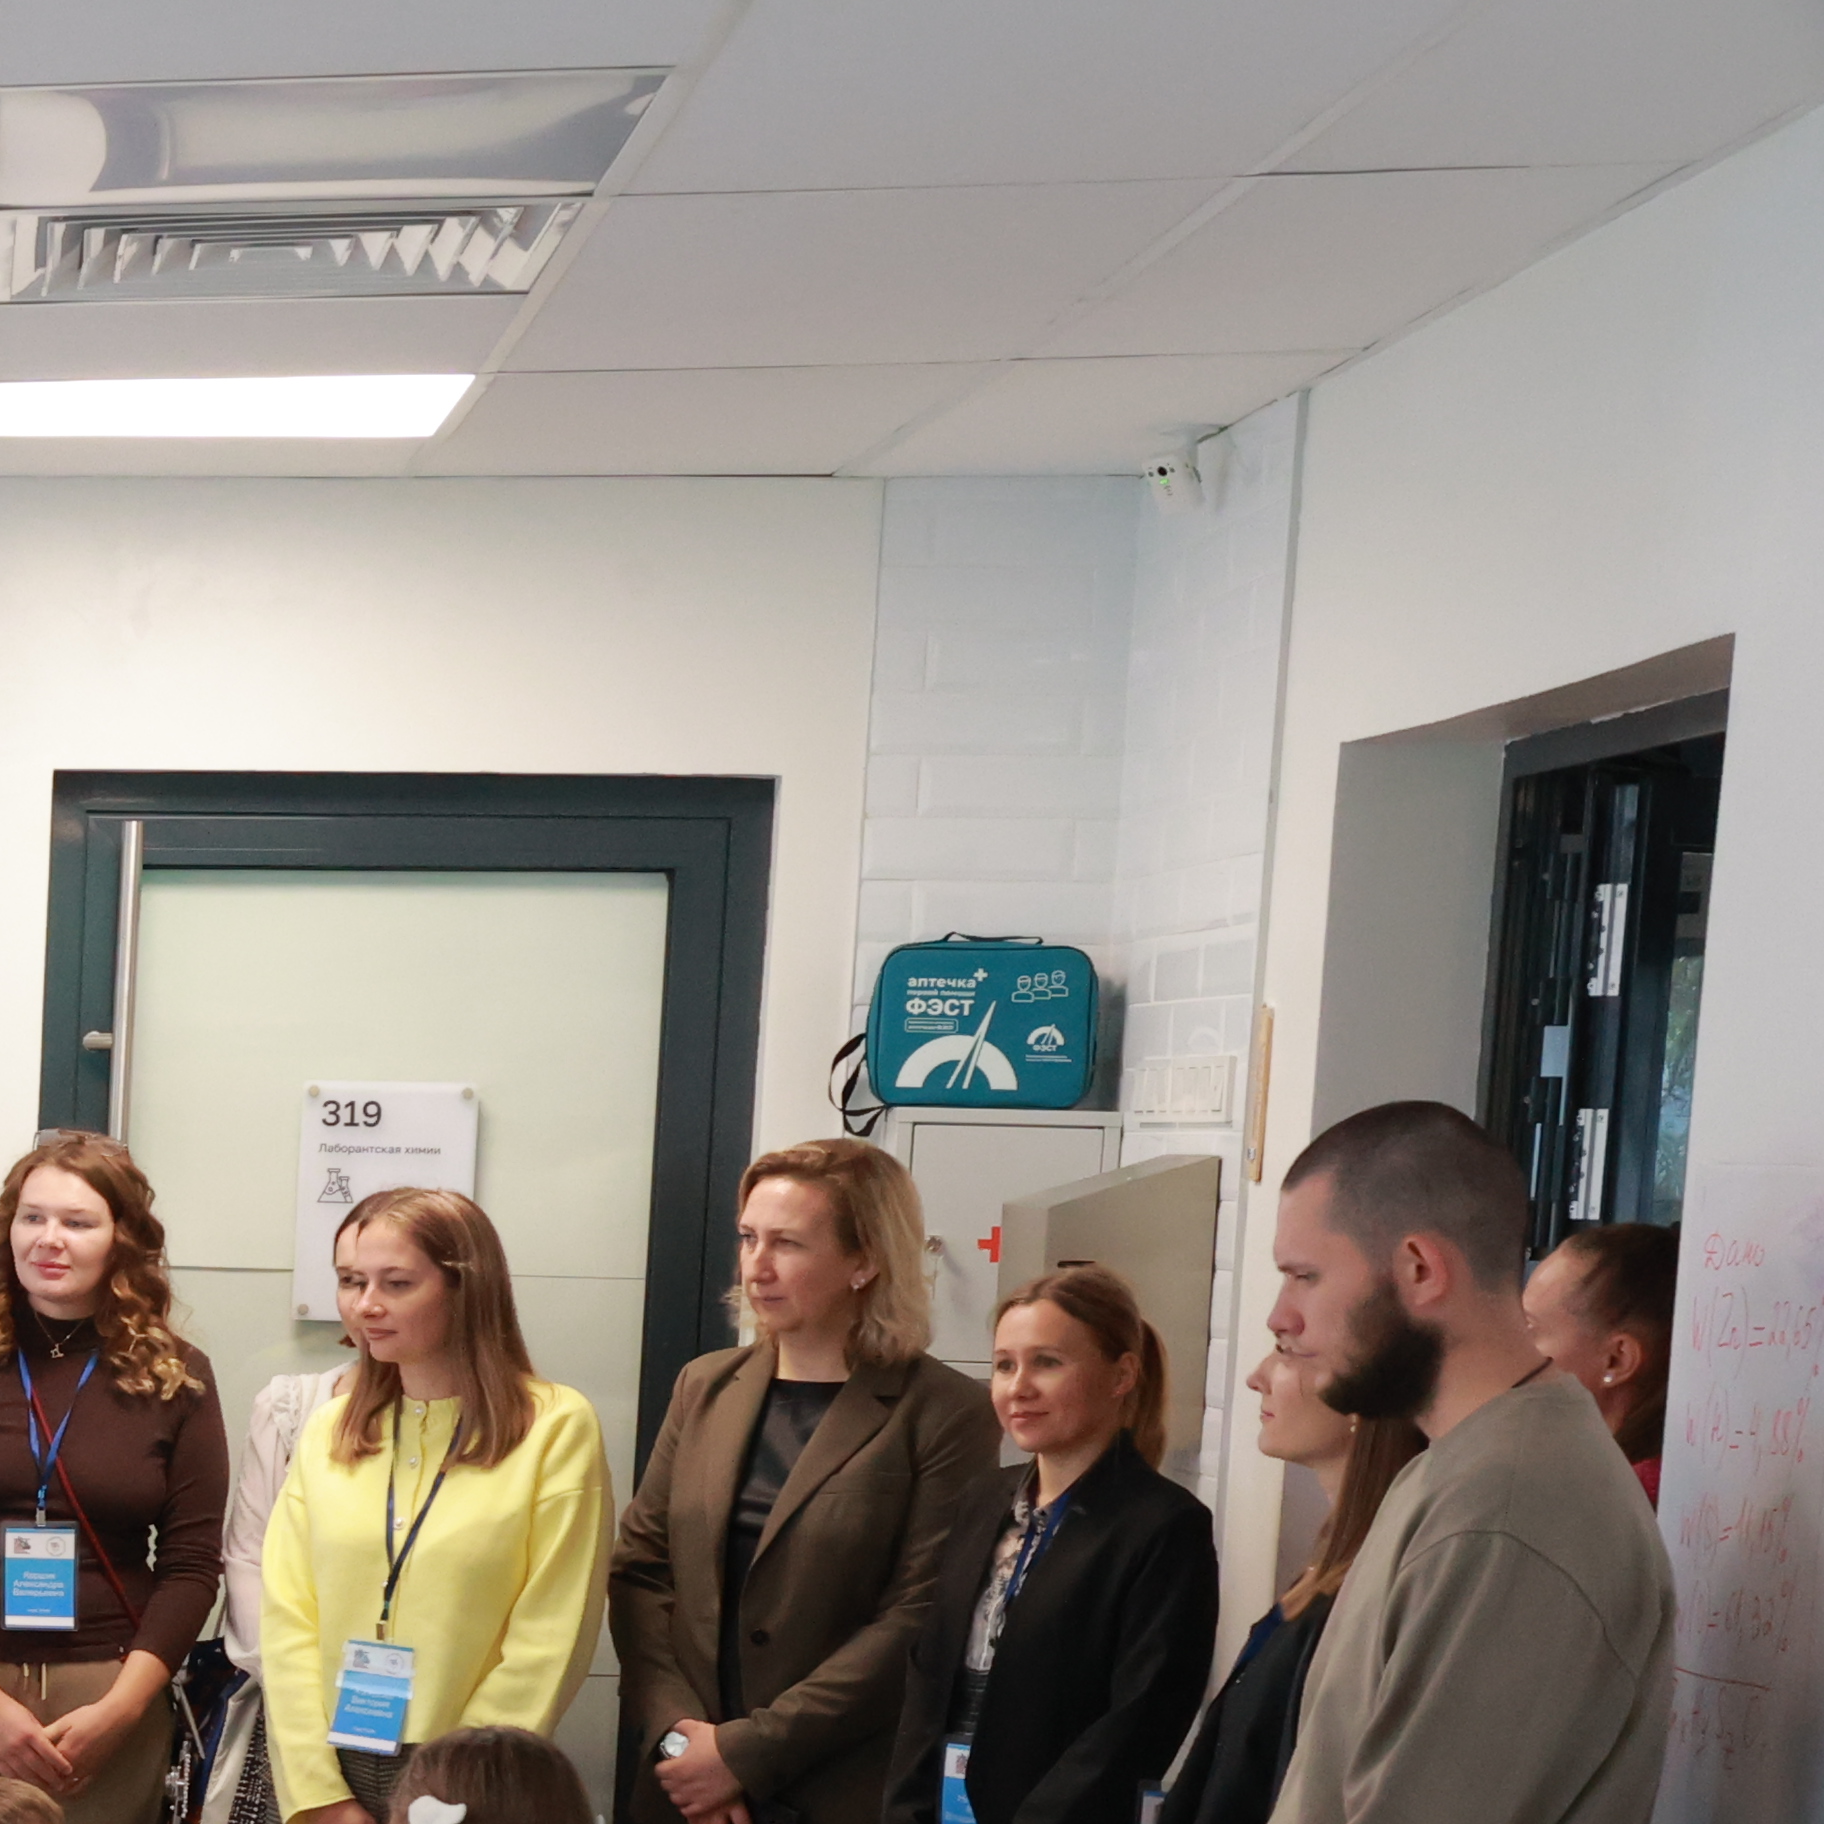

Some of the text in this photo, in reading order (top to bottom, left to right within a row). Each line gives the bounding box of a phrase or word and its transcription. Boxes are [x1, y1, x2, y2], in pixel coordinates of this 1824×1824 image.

[908, 977, 977, 988] аптечка
[906, 998, 975, 1016] ФЭСТ
[321, 1100, 382, 1128] 319
[318, 1143, 441, 1154] Лаборантская химии
